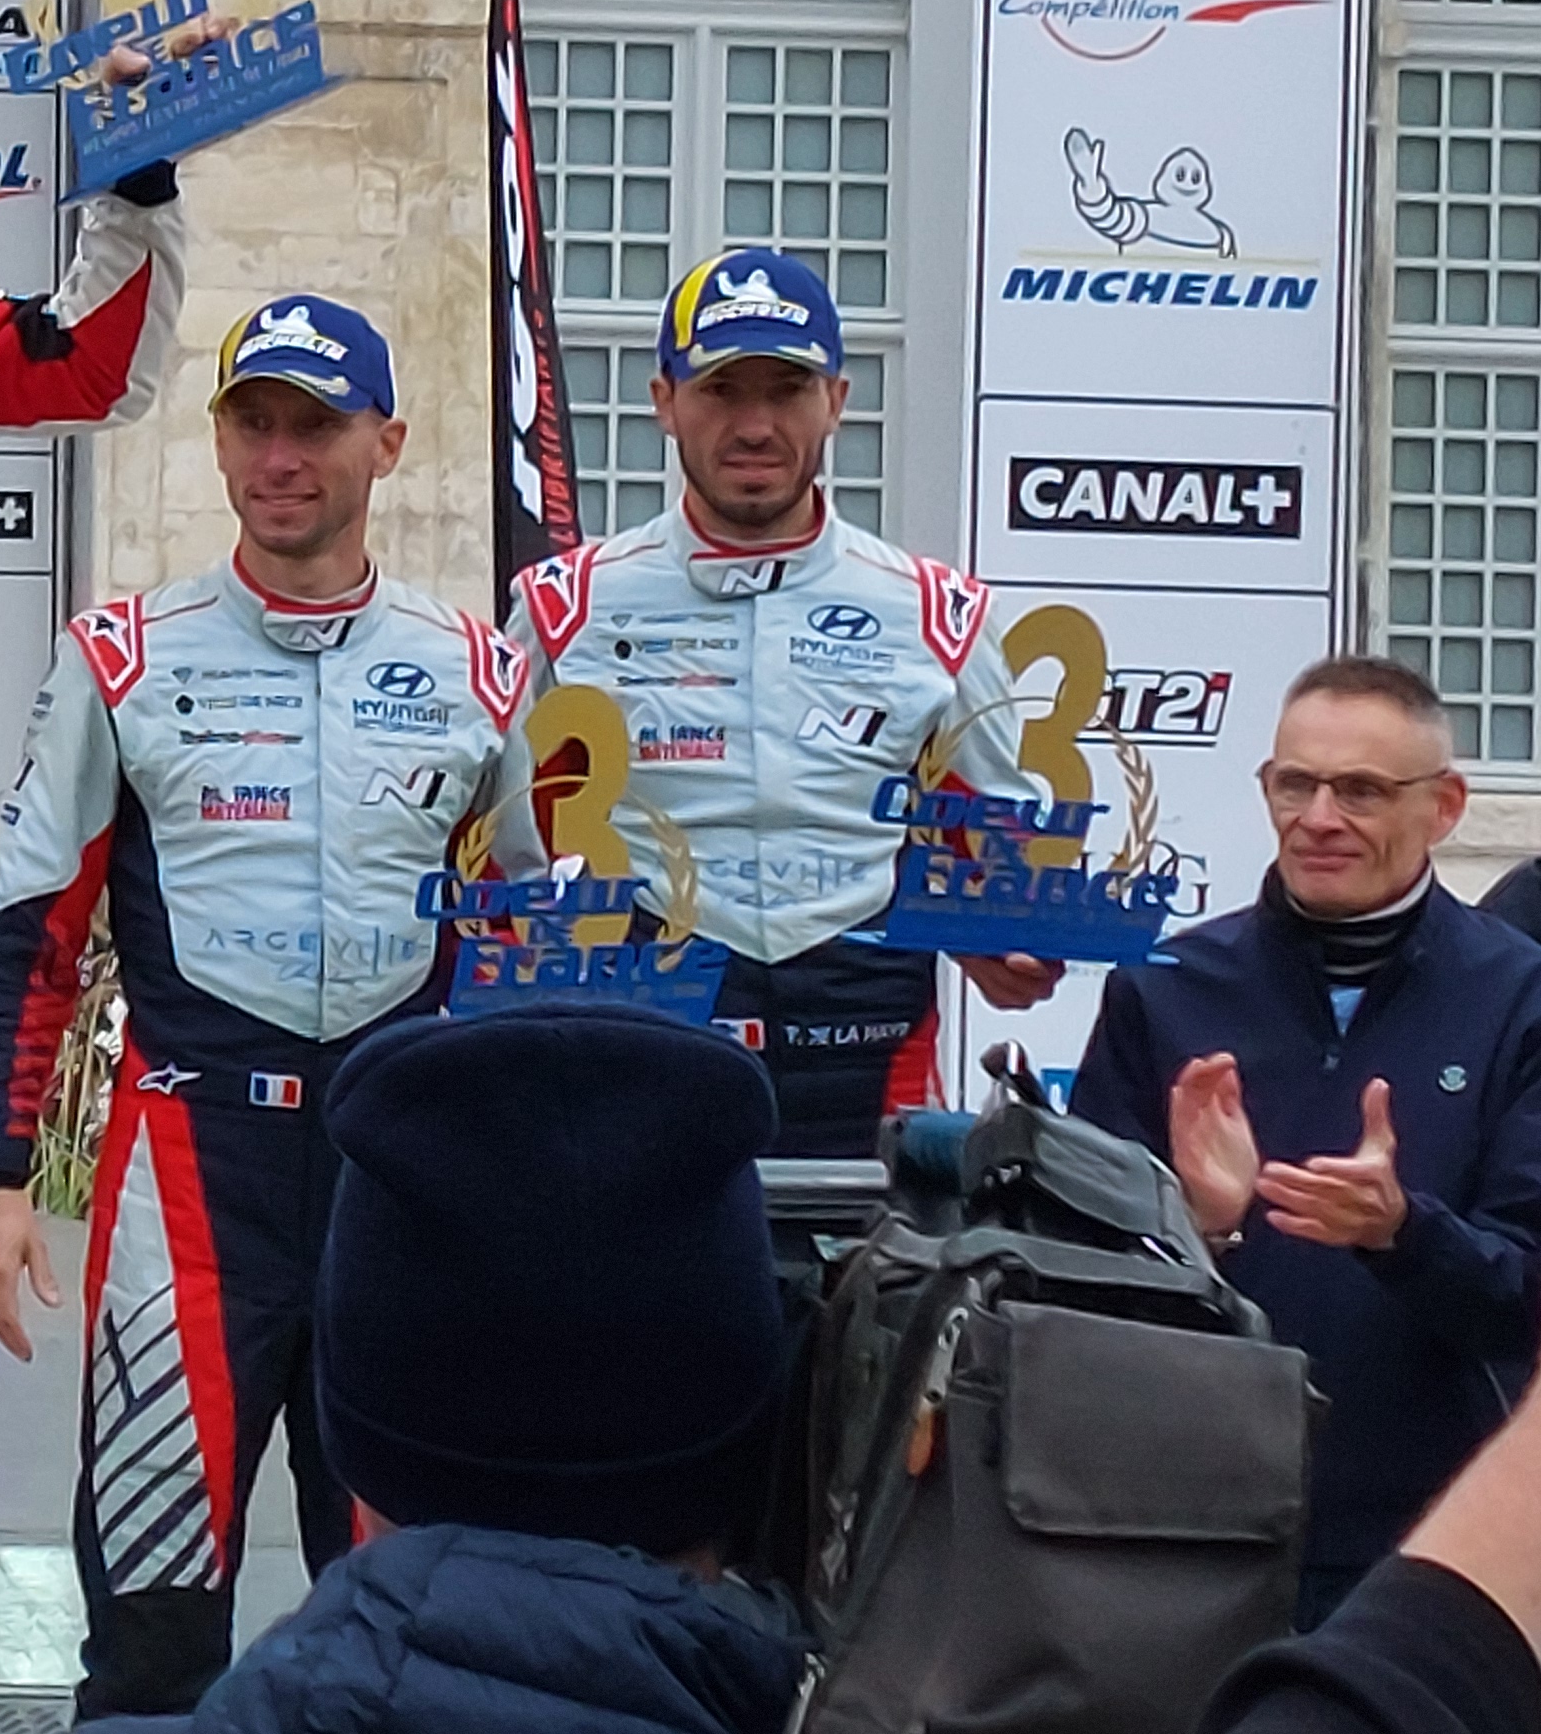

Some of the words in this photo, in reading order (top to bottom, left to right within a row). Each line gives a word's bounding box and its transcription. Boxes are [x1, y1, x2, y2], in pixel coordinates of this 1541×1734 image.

[1001, 267, 1319, 312] MICHELIN
[1017, 465, 1293, 528] CANAL+
[1095, 668, 1235, 736] T2i
